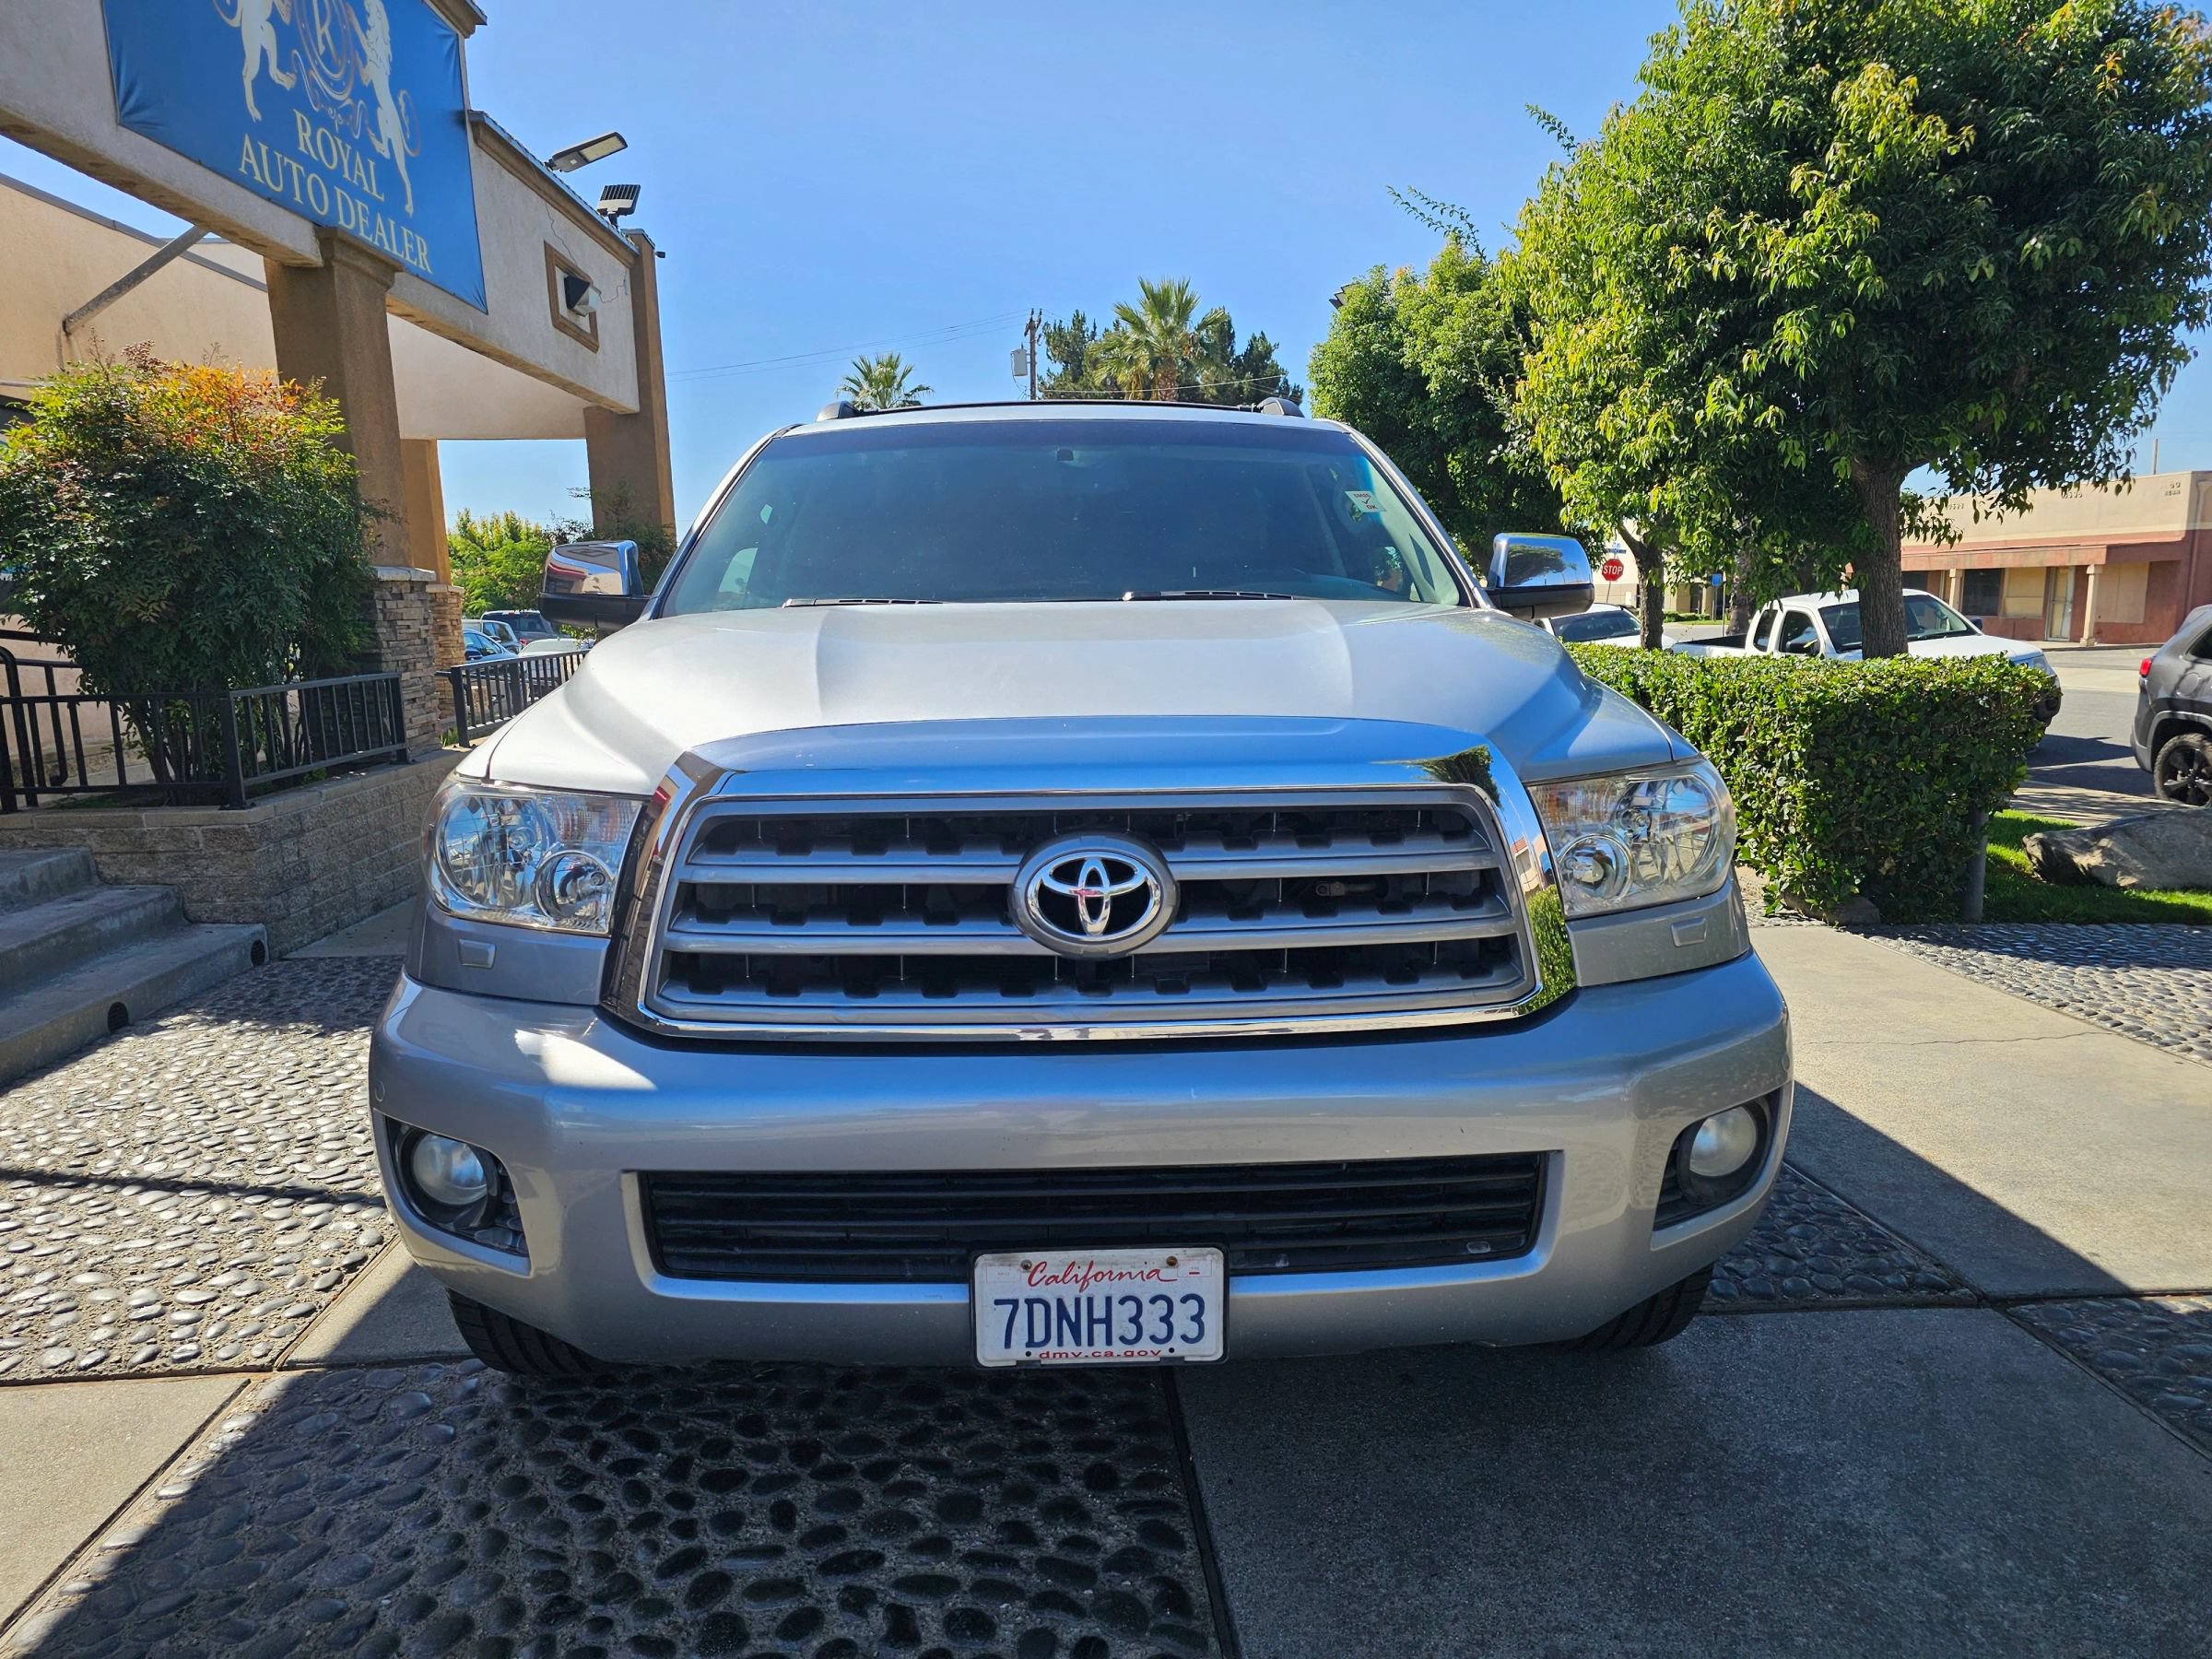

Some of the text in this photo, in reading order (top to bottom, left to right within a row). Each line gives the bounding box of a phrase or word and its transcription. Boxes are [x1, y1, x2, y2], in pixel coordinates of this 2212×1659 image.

[294, 109, 384, 202] ROYAL
[239, 133, 433, 274] AUTO DEALER
[1603, 565, 1623, 575] STOP
[1028, 1259, 1178, 1293] California
[994, 1293, 1206, 1349] 7DNH333
[1039, 1348, 1162, 1359] dmv.ca.gov
